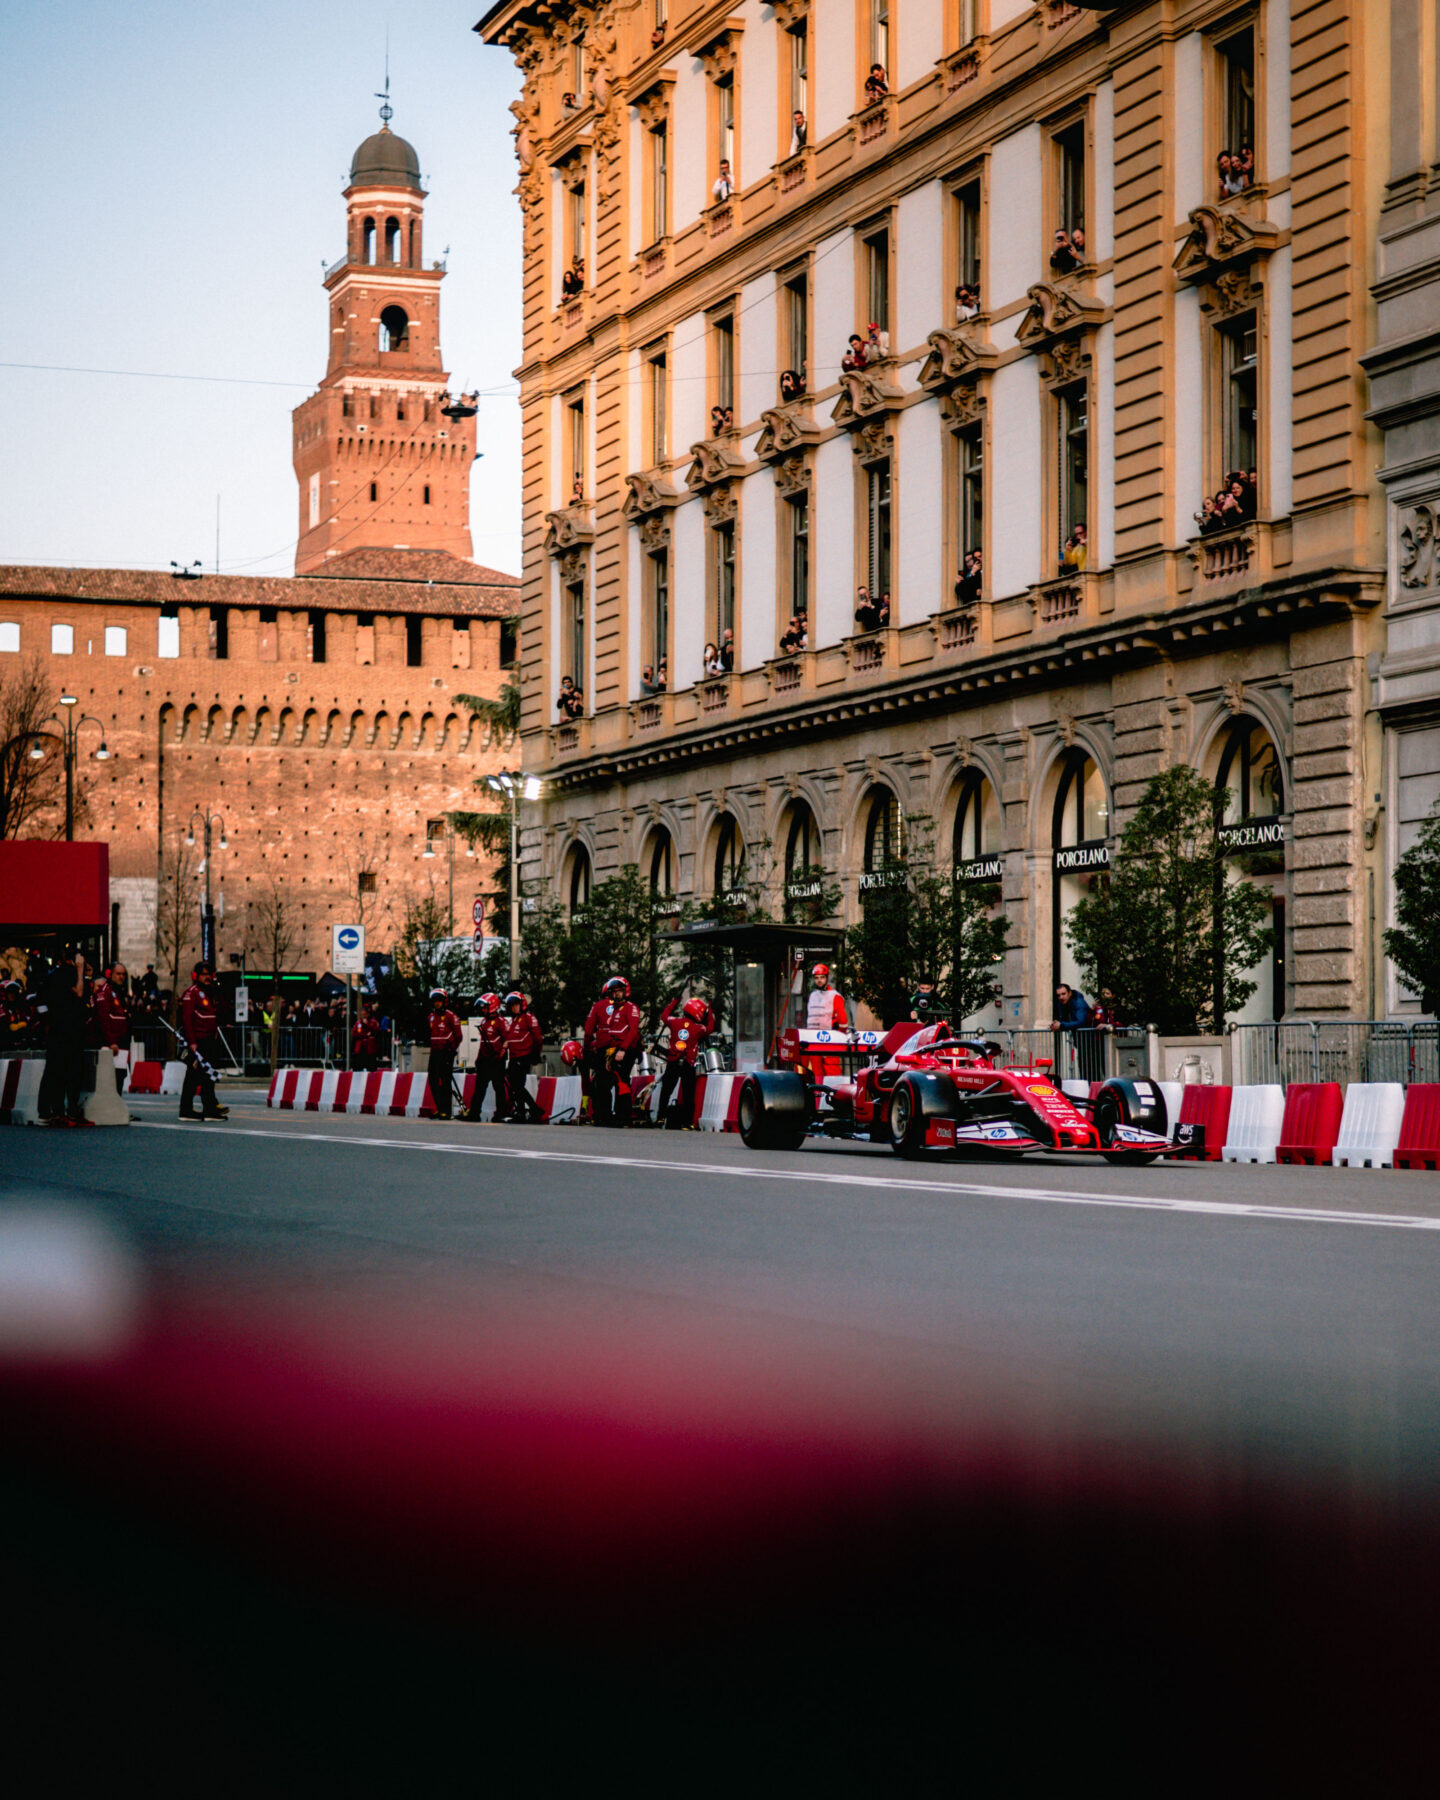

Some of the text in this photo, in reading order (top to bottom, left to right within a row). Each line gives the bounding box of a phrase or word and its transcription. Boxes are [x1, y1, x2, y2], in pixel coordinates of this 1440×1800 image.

[475, 906, 481, 919] 30
[818, 1031, 831, 1042] hp
[864, 1032, 877, 1043] hp
[992, 1128, 1007, 1138] hp
[1179, 1124, 1193, 1136] aws
